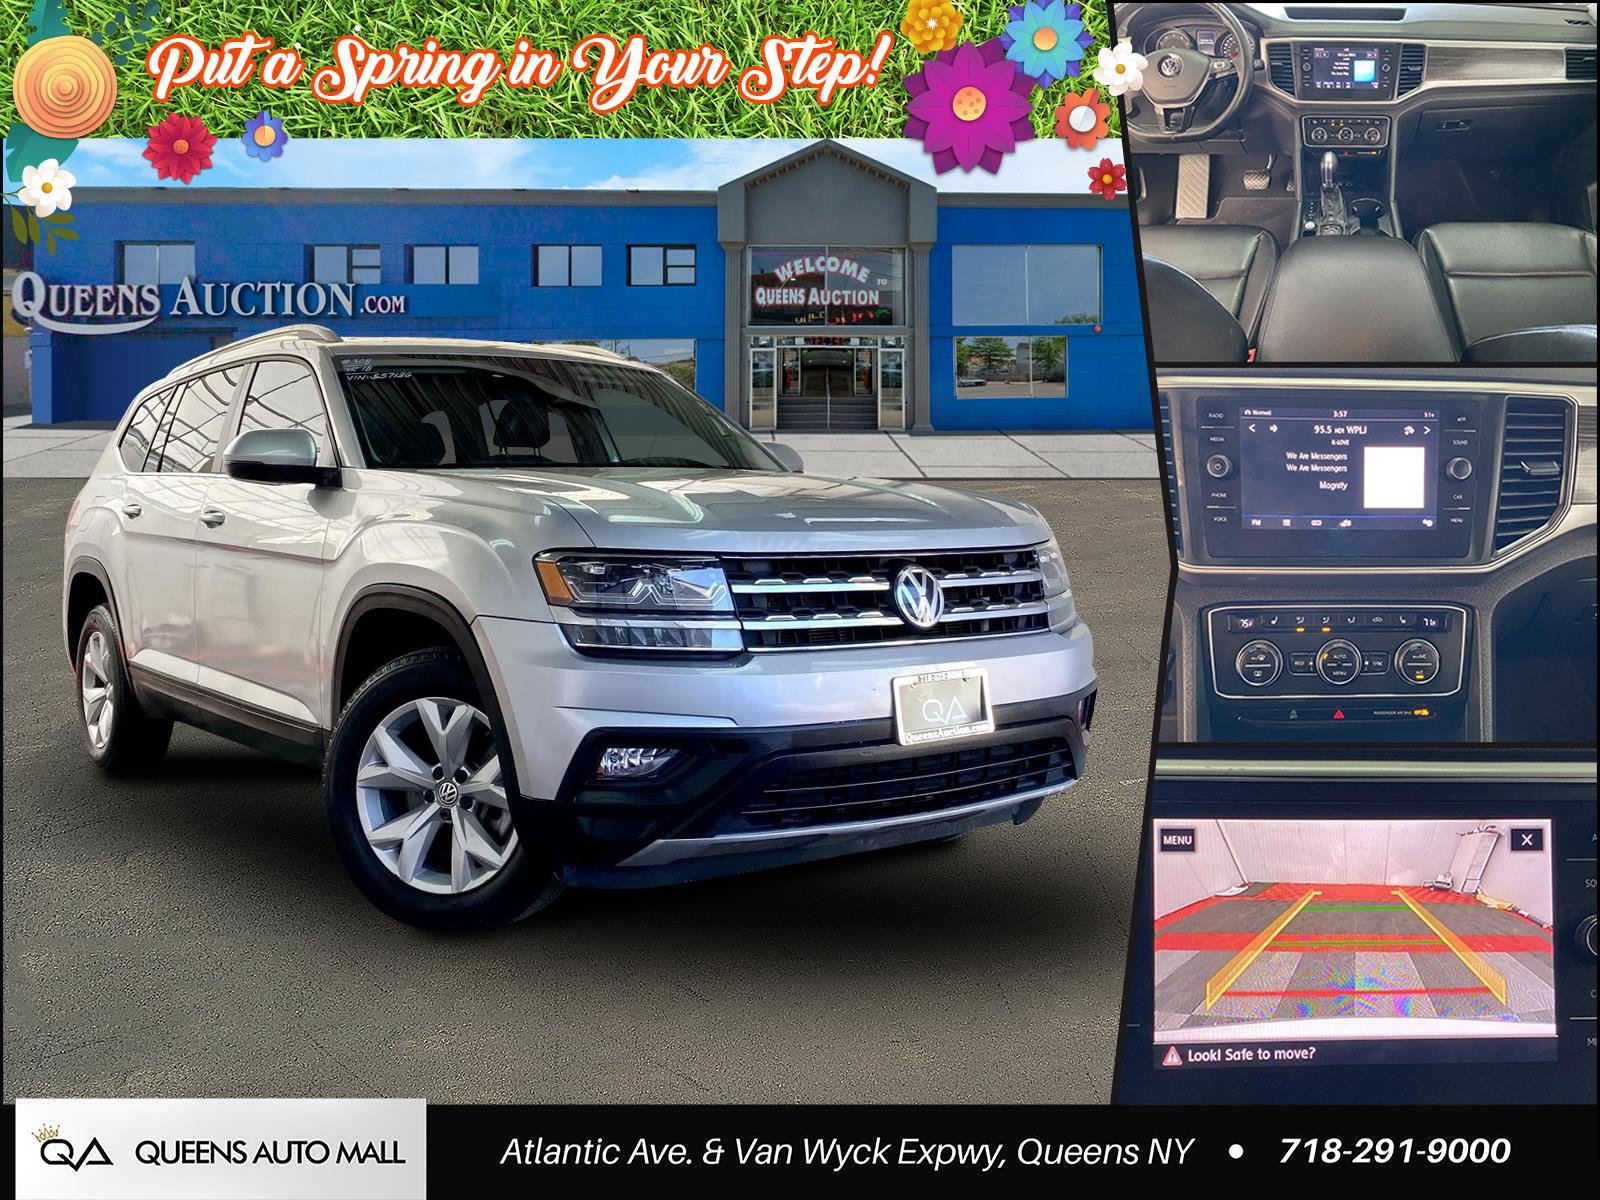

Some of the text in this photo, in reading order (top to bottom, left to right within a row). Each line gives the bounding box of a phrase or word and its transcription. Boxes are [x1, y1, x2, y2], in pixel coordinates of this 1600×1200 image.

[774, 256, 871, 283] WELCOME
[755, 287, 880, 306] QUEENS AUCTION
[12, 271, 161, 334] QUEENS
[1333, 410, 1348, 418] 3:57
[1314, 425, 1332, 434] 95.5
[1346, 425, 1367, 435] WPLJ
[1286, 452, 1348, 462] We Are Messengers
[1286, 464, 1348, 473] We Are Messengers
[1163, 835, 1193, 845] MENU
[1188, 1046, 1316, 1062] Look! Safe to move?
